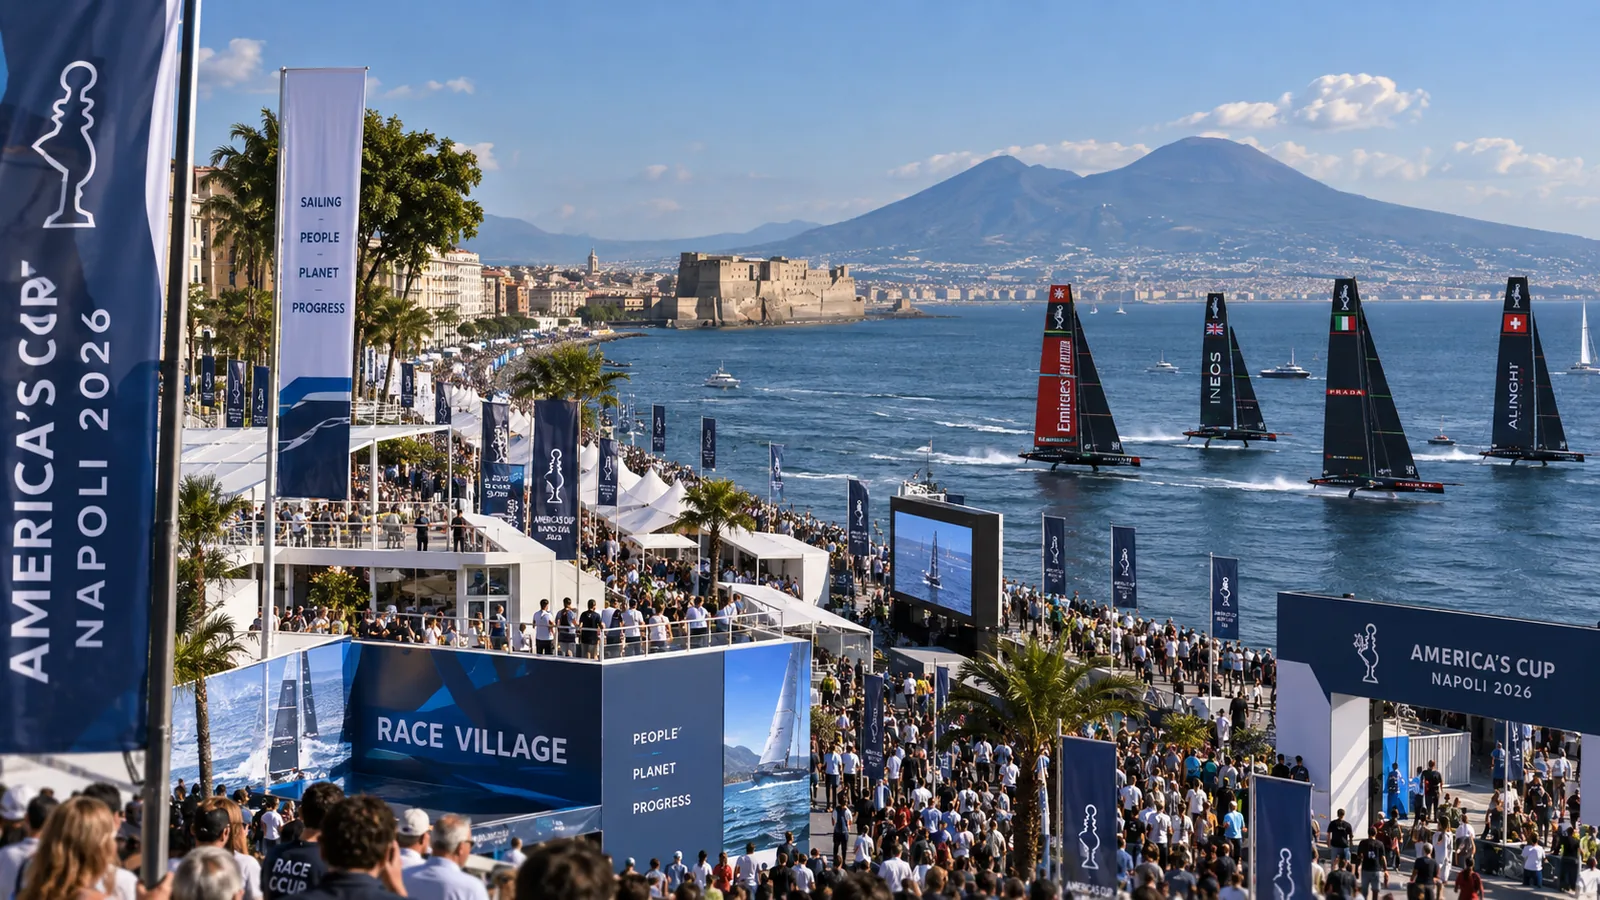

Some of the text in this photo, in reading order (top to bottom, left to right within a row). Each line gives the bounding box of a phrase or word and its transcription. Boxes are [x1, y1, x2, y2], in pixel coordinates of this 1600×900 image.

[300, 196, 342, 208] SAILING
[300, 232, 340, 243] PEOPLE
[299, 267, 339, 278] PLANET
[292, 302, 345, 314] PROGRESS
[75, 308, 111, 648] NAPOLI 2026
[9, 379, 56, 685] AMERICA'S
[1410, 644, 1556, 679] AMERICA'S CUP
[1431, 672, 1532, 699] NAPOLI 2026
[377, 716, 568, 765] RACE VILLAGE
[633, 762, 676, 780] PLANET
[633, 794, 692, 815] PROGRESS
[272, 858, 312, 878] RACE
